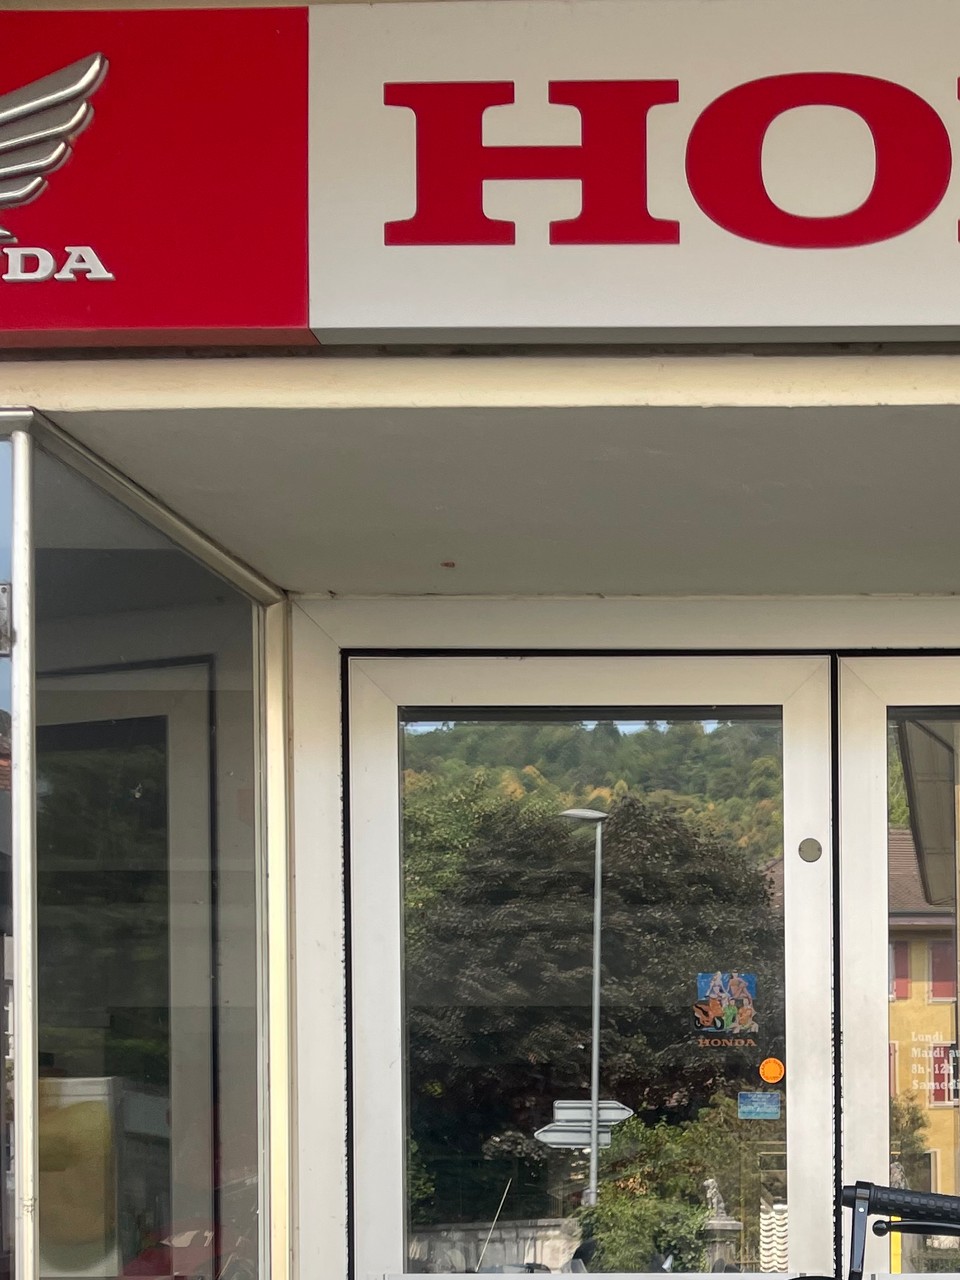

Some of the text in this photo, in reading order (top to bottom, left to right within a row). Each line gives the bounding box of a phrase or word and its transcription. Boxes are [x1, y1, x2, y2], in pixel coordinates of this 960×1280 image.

[0, 246, 115, 281] DA
[911, 1031, 943, 1042] Lundi
[698, 1038, 757, 1047] HONDA
[911, 1048, 944, 1058] Mardi
[911, 1064, 925, 1074] 8h
[911, 1079, 960, 1090] Samedi
